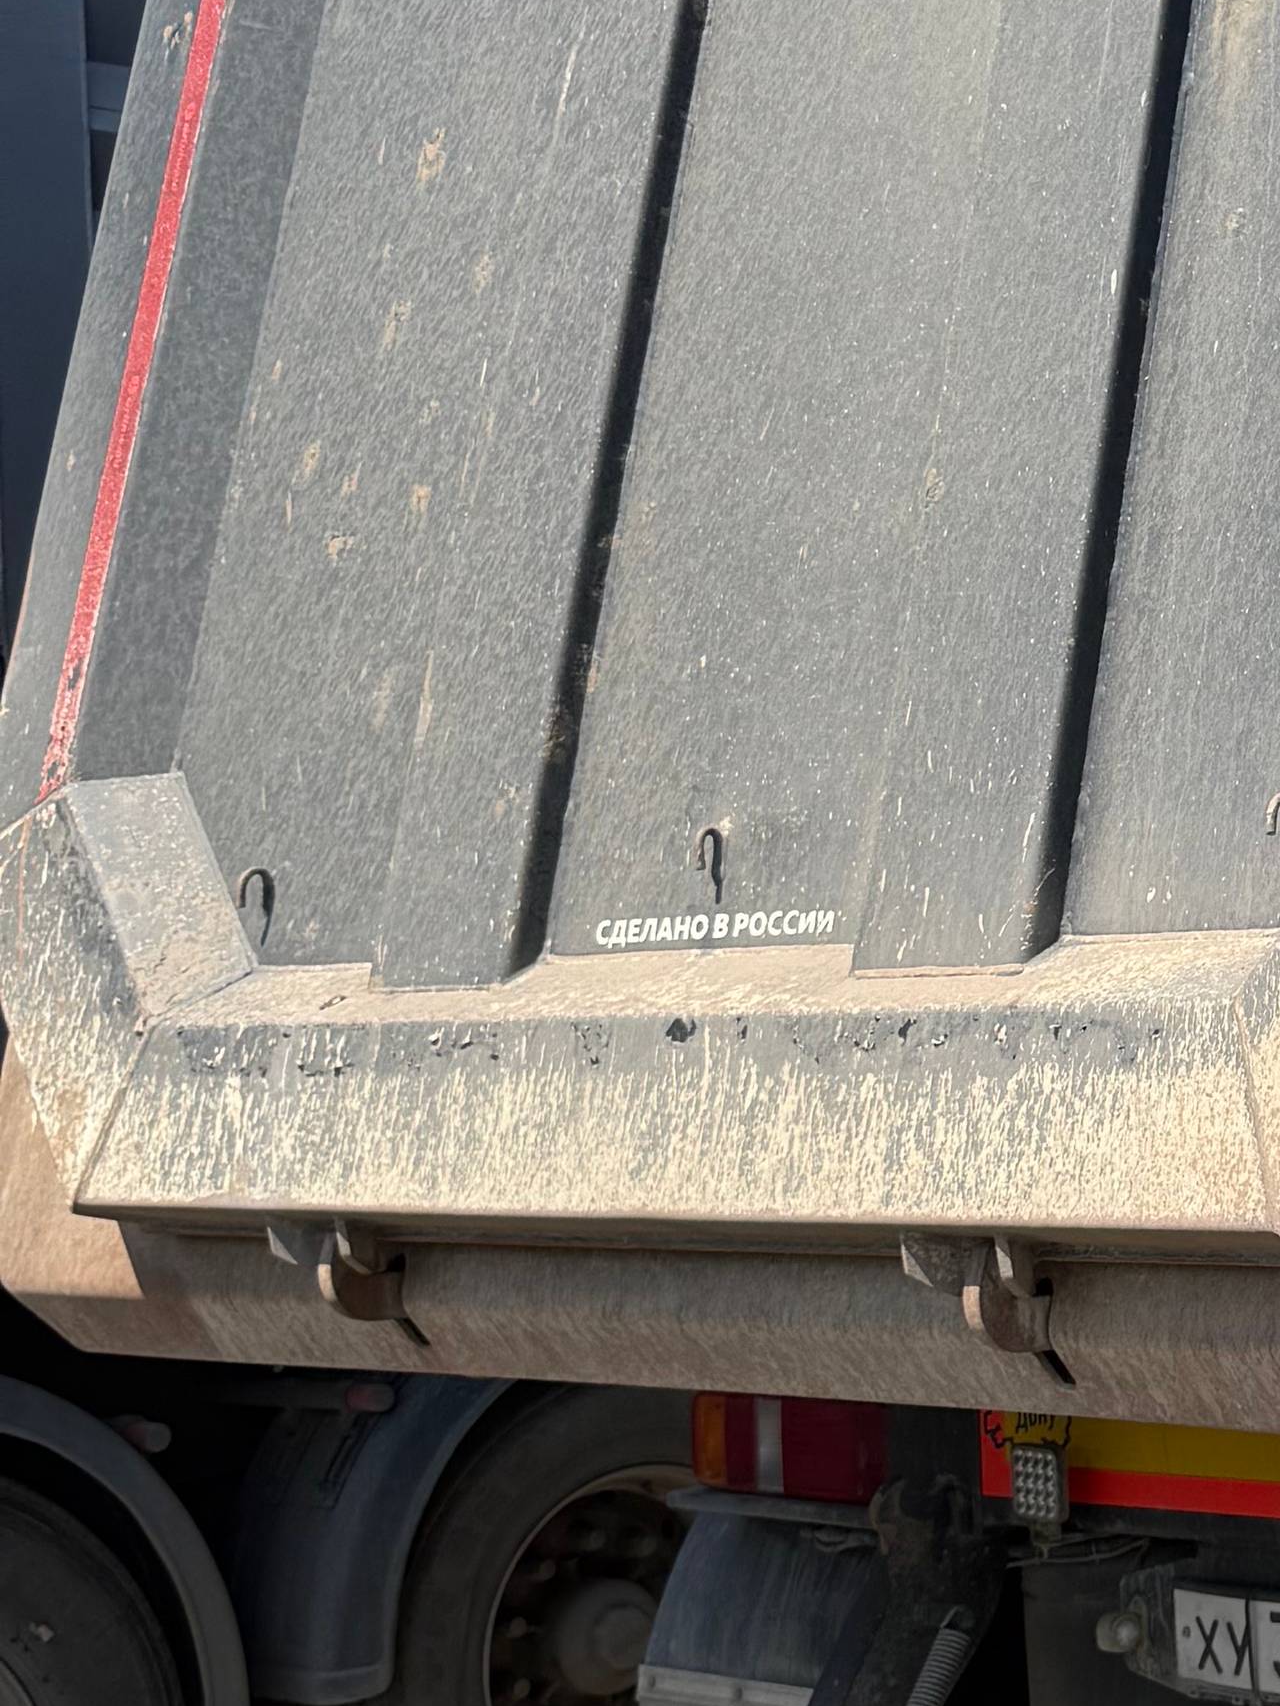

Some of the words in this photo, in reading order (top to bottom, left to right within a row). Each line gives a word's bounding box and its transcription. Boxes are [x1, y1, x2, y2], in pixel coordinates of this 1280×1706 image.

[595, 914, 709, 949] СДЕЛАНО
[712, 913, 729, 940] В
[732, 910, 836, 940] РОССИИ
